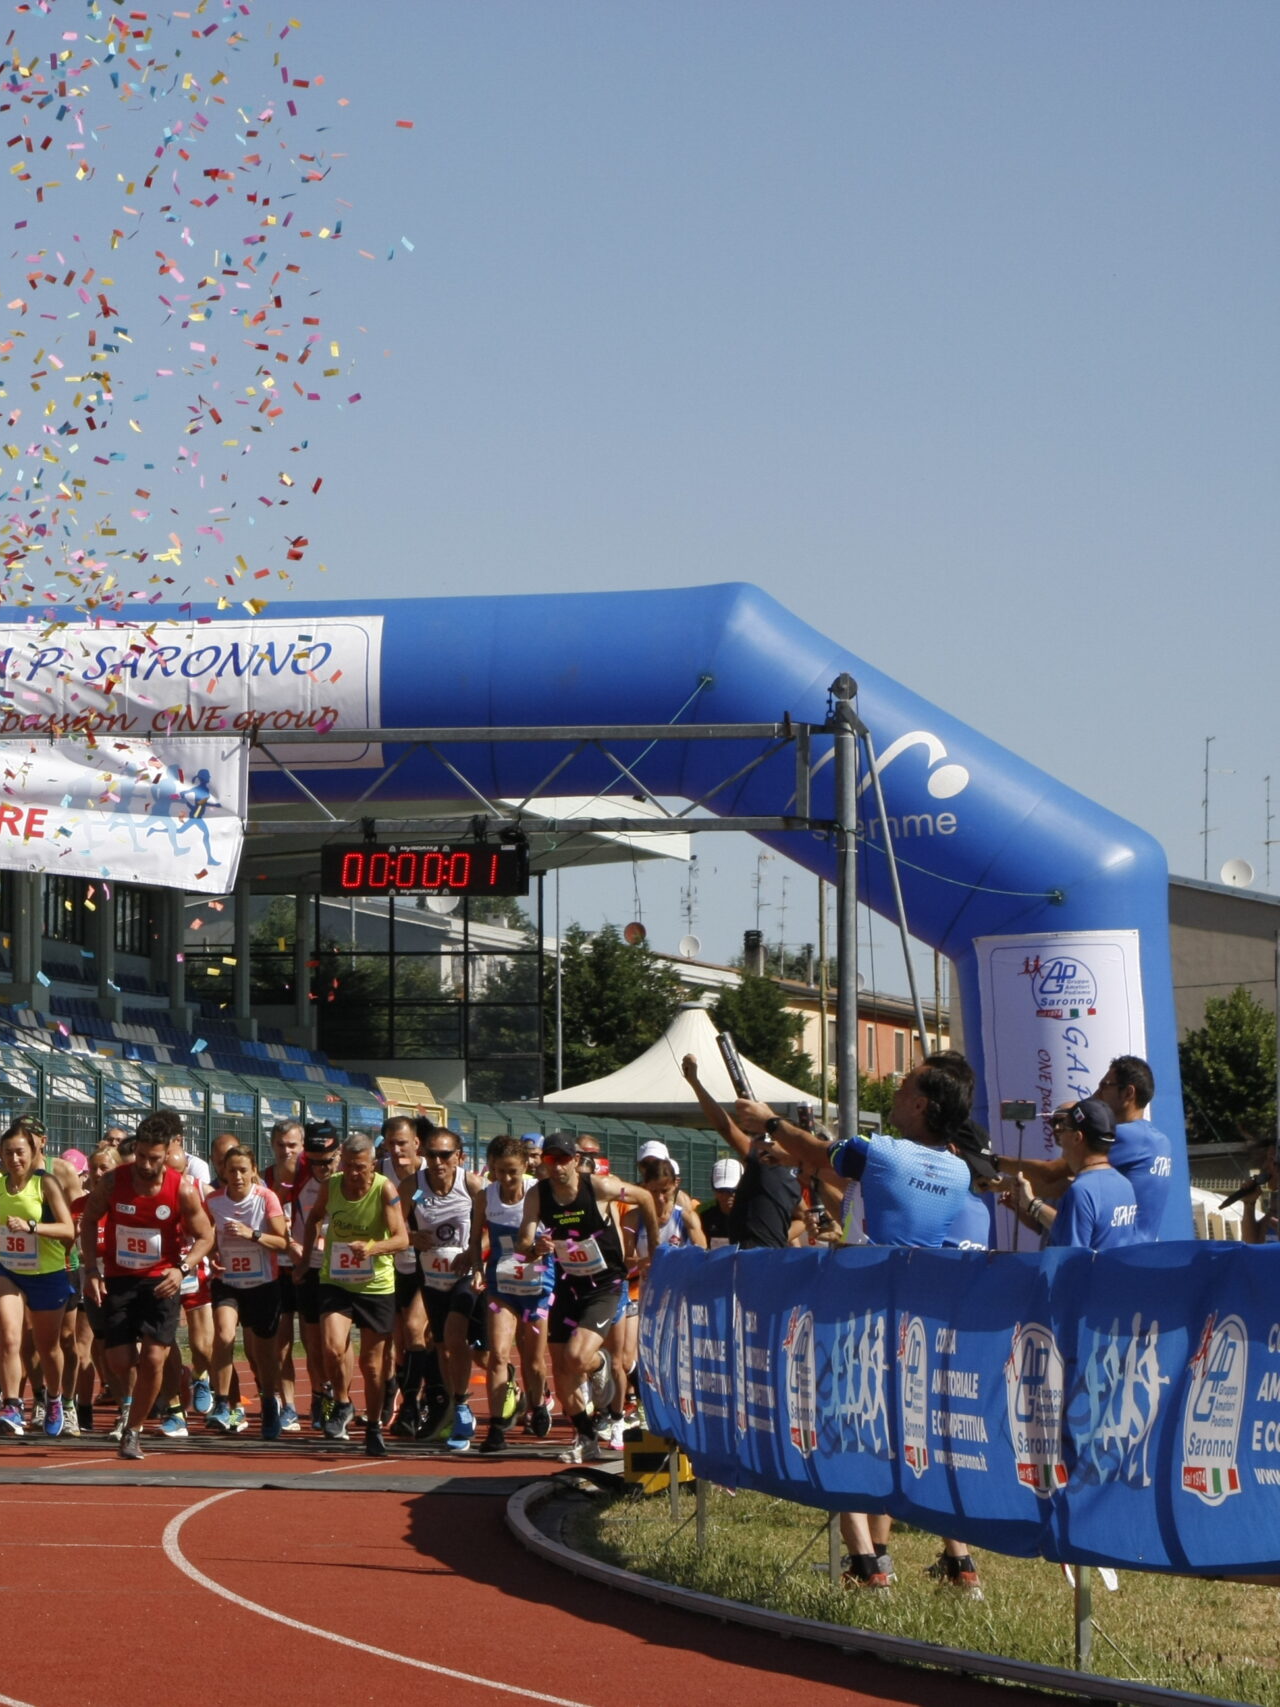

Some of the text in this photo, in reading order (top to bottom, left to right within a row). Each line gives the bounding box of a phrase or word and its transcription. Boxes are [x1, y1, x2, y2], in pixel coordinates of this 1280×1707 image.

[82, 640, 333, 682] SARONNO
[152, 703, 231, 732] ONE
[1040, 996, 1093, 1007] Saronno
[1037, 1048, 1053, 1084] ONE
[907, 1176, 950, 1196] FRANK
[1110, 1203, 1138, 1228] STAFF
[6, 1236, 25, 1252] 36
[127, 1237, 147, 1254] 29
[231, 1257, 252, 1272] 22
[340, 1253, 362, 1269] 24
[513, 1265, 525, 1281] 3
[1220, 1383, 1239, 1398] Gruppo
[1035, 1402, 1060, 1414] Amator
[1214, 1400, 1236, 1412] Amatori
[931, 1409, 937, 1435] E
[1035, 1416, 1061, 1429] Podism
[1210, 1414, 1234, 1429] Podismo
[1017, 1431, 1061, 1455] Saronn
[1252, 1419, 1263, 1451] E
[1187, 1432, 1233, 1458] Saronno
[1184, 1470, 1207, 1487] dal 1974
